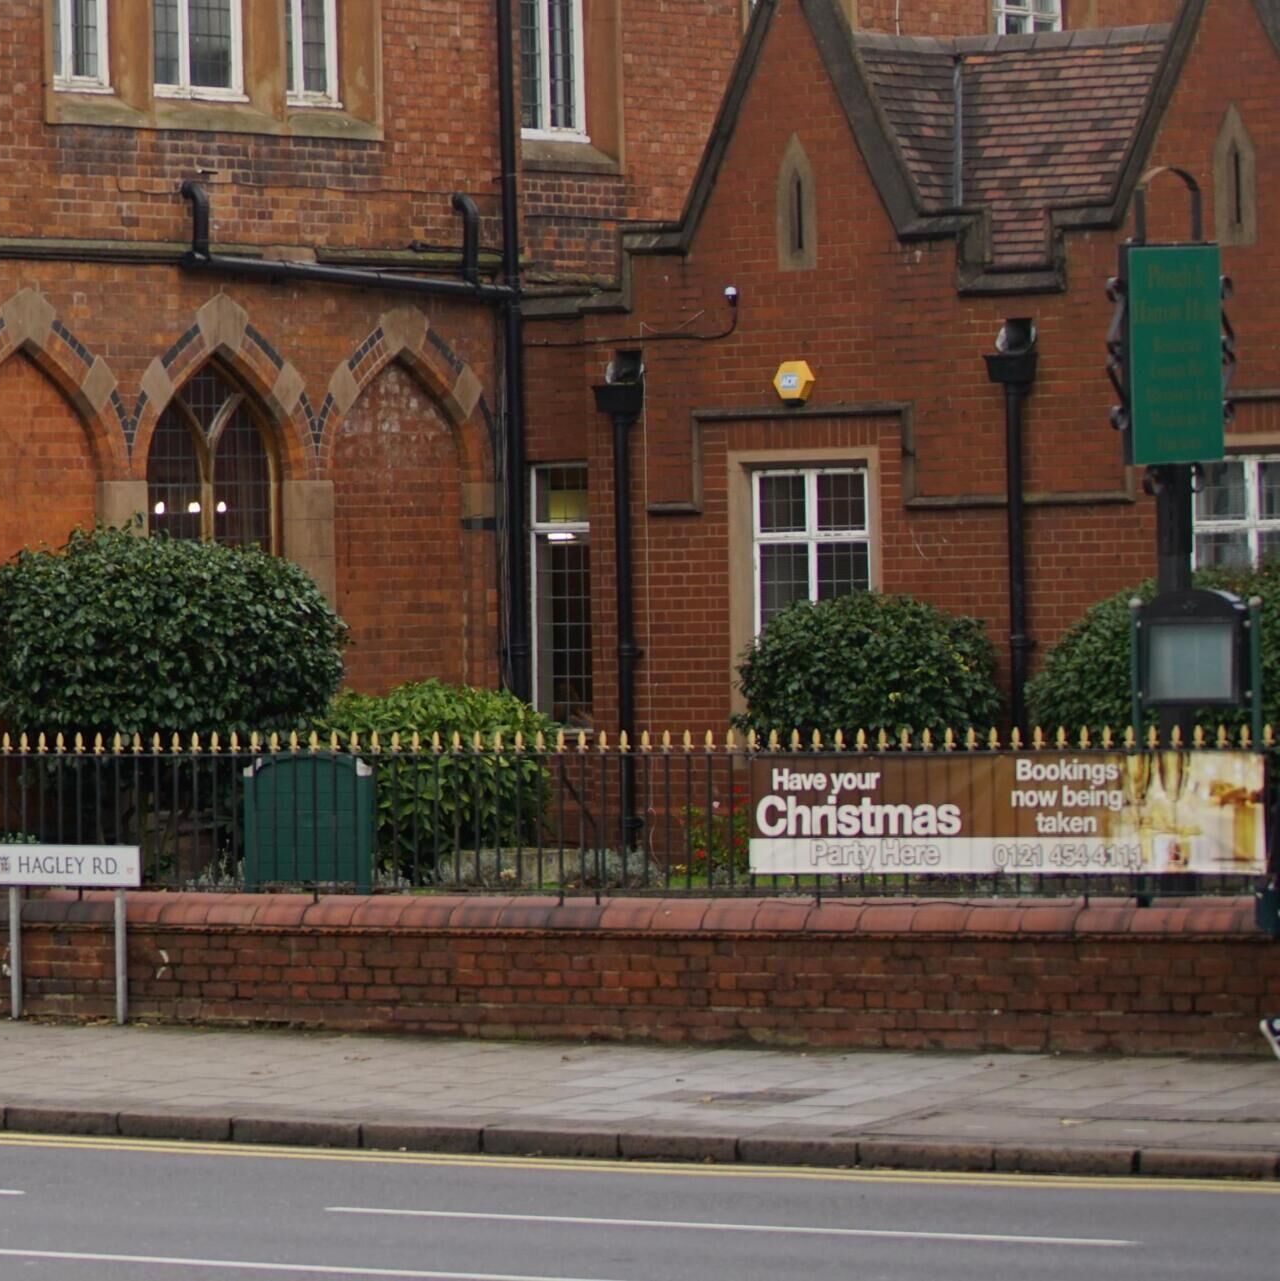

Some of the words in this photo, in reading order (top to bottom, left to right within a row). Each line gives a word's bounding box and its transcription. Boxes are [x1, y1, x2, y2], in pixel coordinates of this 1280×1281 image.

[772, 768, 827, 791] Have
[831, 772, 881, 794] your
[1015, 758, 1119, 786] Bookings
[1011, 789, 1057, 807] now
[1062, 785, 1123, 811] being
[756, 795, 962, 836] Christmas
[1035, 812, 1097, 833] taken
[18, 856, 85, 874] HAGLEY
[810, 839, 876, 870] Party
[879, 839, 940, 866] Here
[993, 844, 1043, 867] 0121
[1049, 844, 1087, 867] 454
